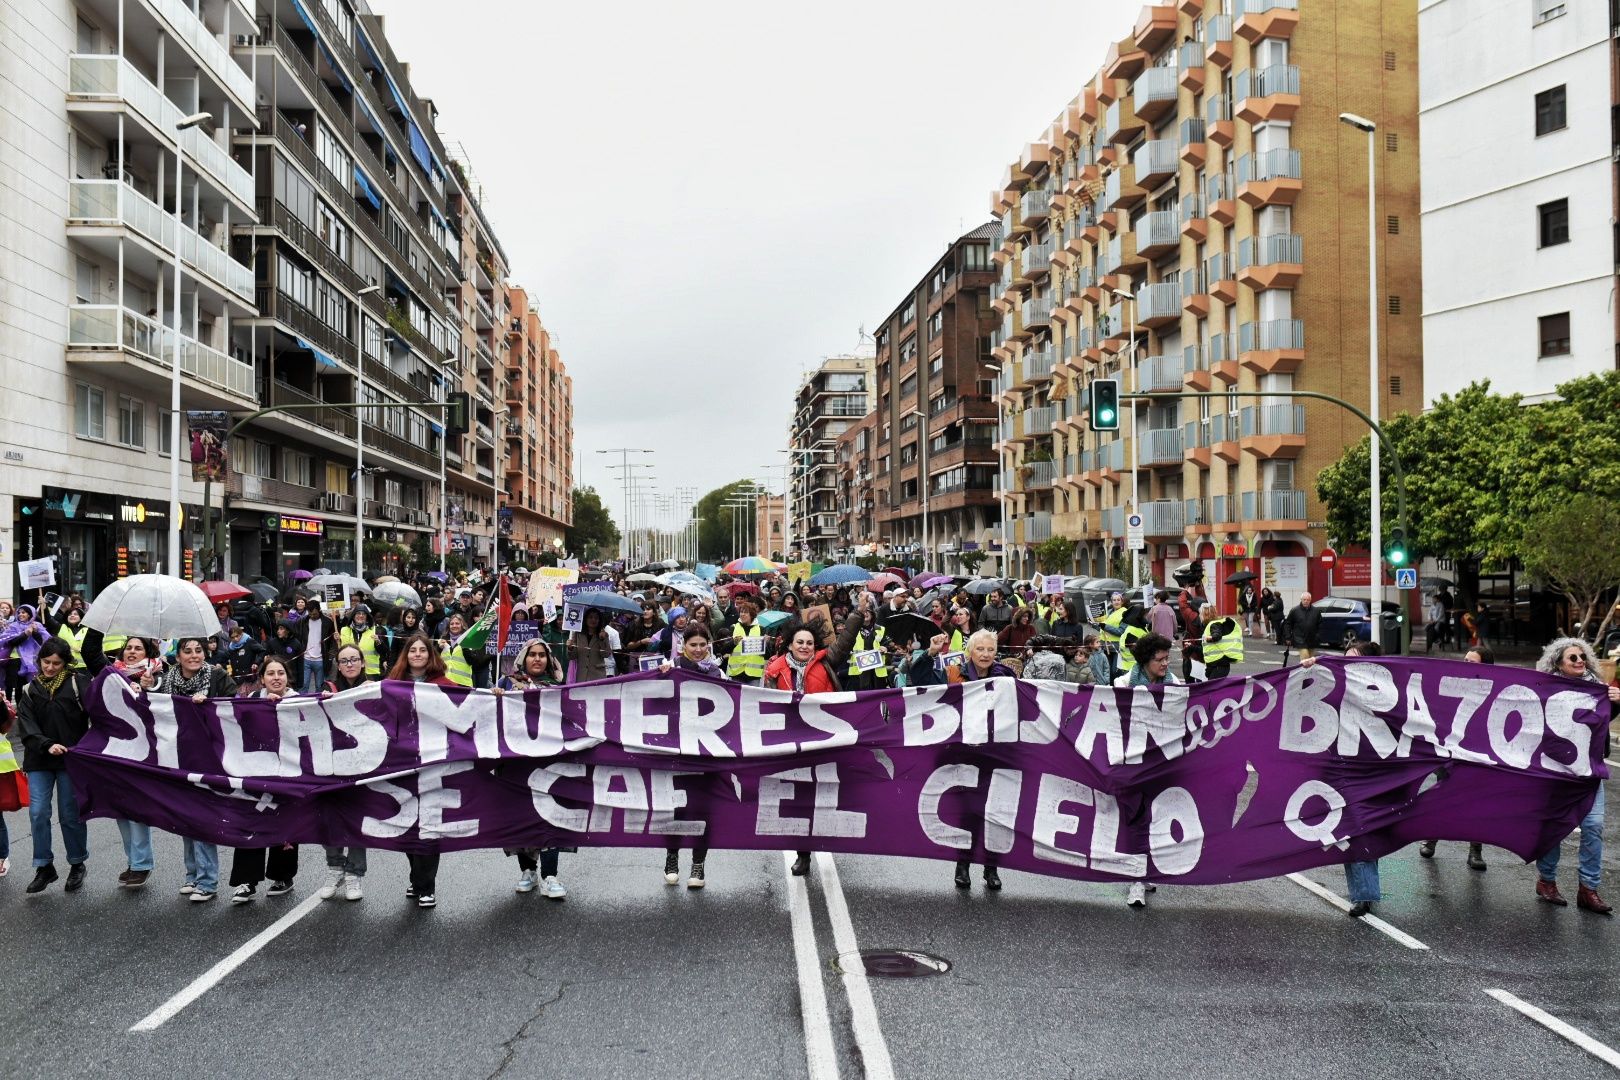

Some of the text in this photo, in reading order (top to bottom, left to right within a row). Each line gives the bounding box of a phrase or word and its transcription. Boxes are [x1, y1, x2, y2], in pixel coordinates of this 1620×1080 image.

[101, 672, 179, 769] SI
[215, 681, 389, 777] LAS
[902, 676, 1190, 765] BAJAN
[1279, 662, 1600, 777] BRAZOS
[354, 760, 1205, 877] SE CAE EL CIELO
